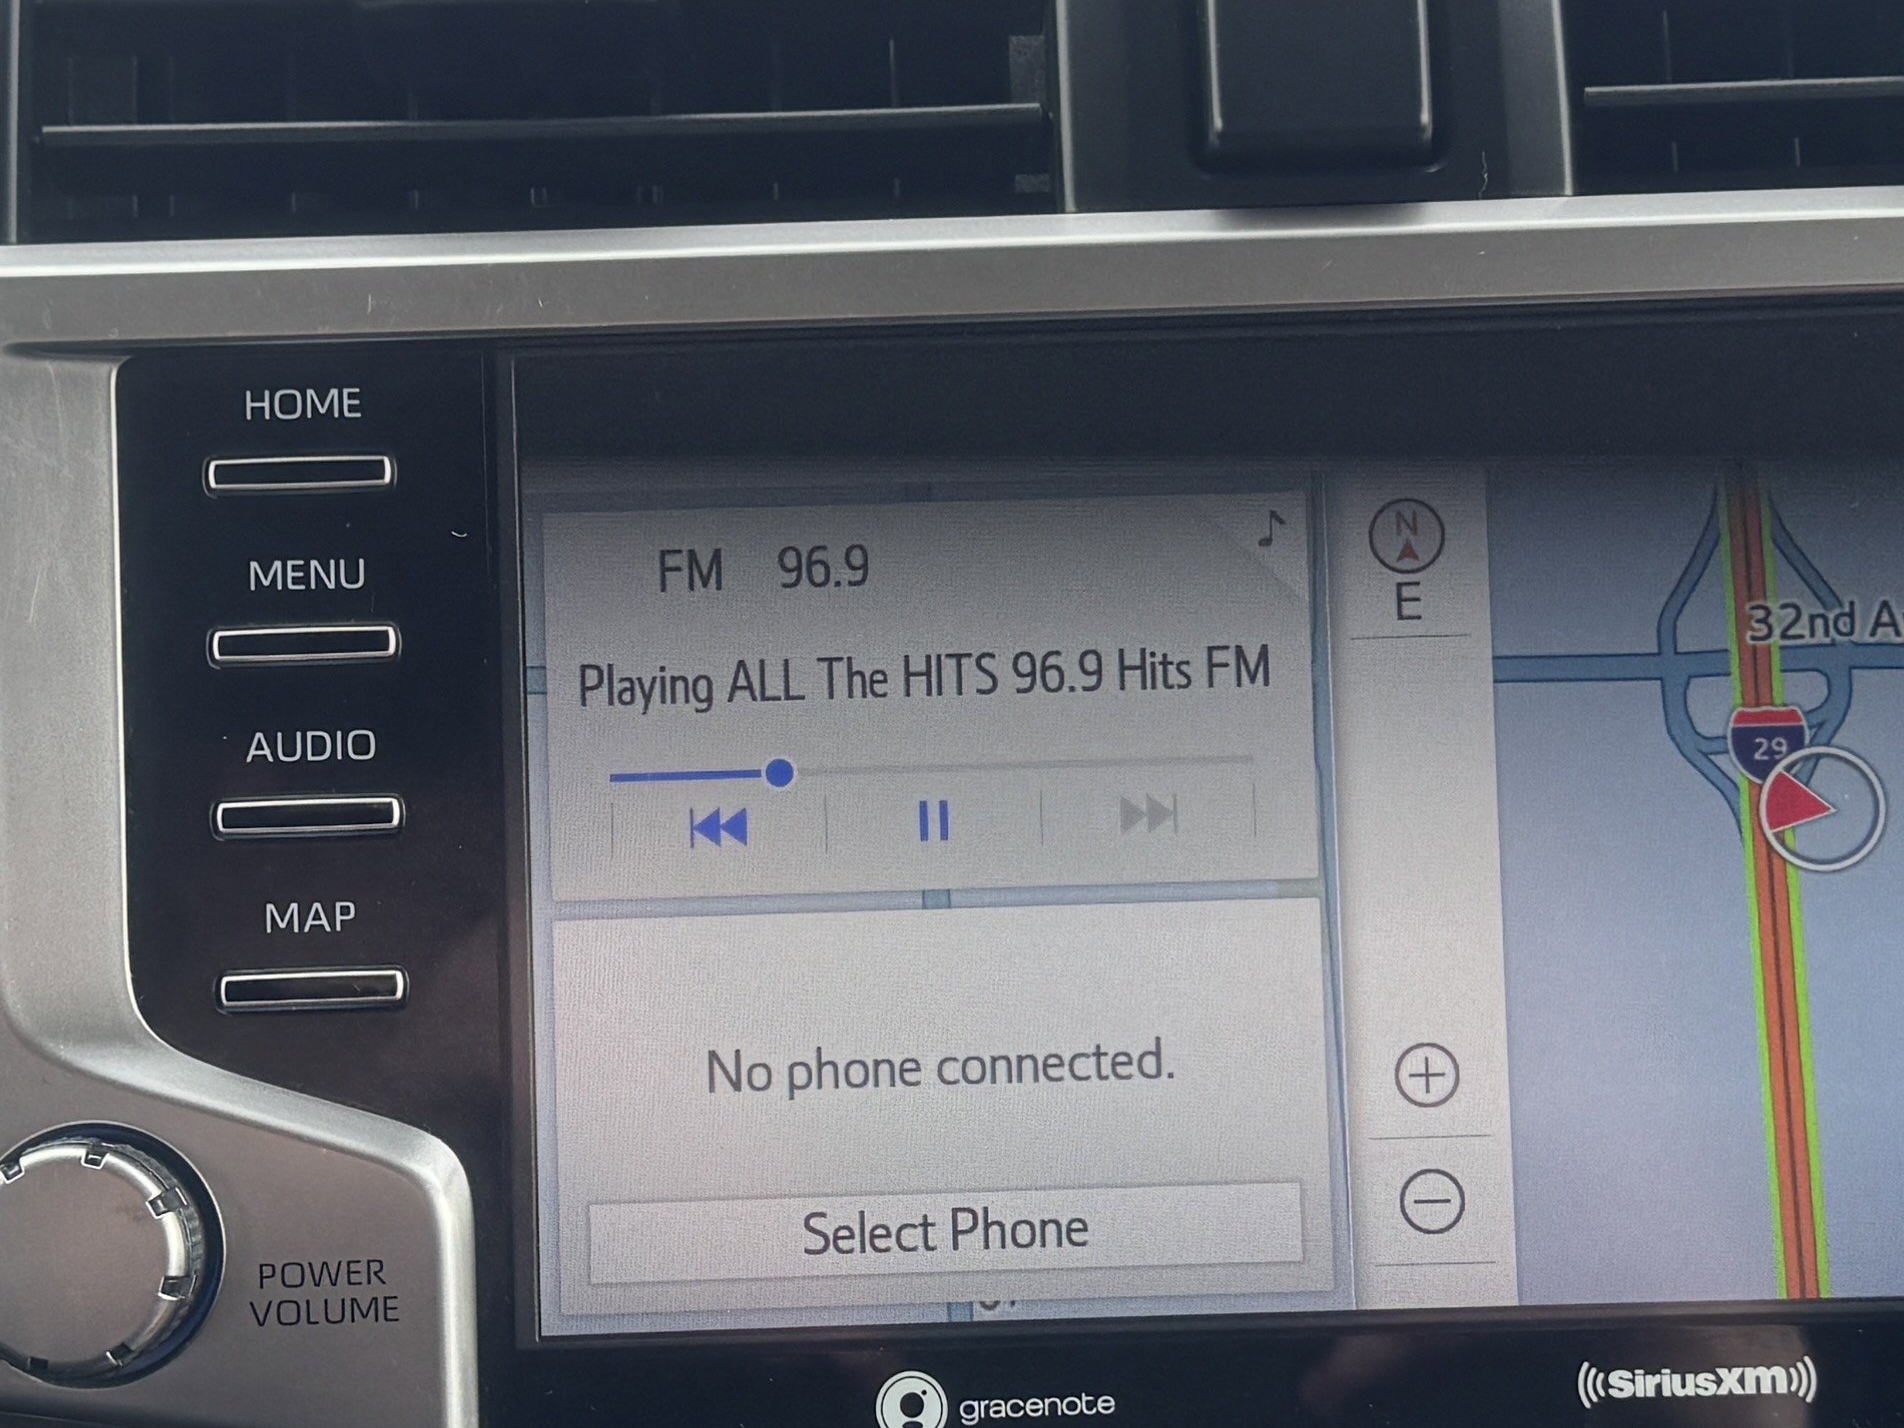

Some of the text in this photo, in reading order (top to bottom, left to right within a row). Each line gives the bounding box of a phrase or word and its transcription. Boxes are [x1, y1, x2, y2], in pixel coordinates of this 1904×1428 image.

[245, 387, 362, 420] HOME
[1396, 509, 1418, 537] N
[249, 558, 366, 591] MENU
[658, 544, 870, 592] FM 96.9
[1396, 580, 1423, 621] E
[1746, 601, 1856, 642] 32nd
[579, 643, 1271, 714] Playing ALL The HITS 96.9 Hits FM
[246, 729, 377, 763] AUDIO
[1753, 737, 1789, 760] 29
[264, 901, 356, 933] MAP
[707, 1036, 1176, 1101] No phone connected.
[802, 1206, 1089, 1257] Select Phone
[259, 1259, 386, 1289] POWER
[249, 1295, 400, 1327] VOLUME
[959, 1393, 1116, 1426] gracenote
